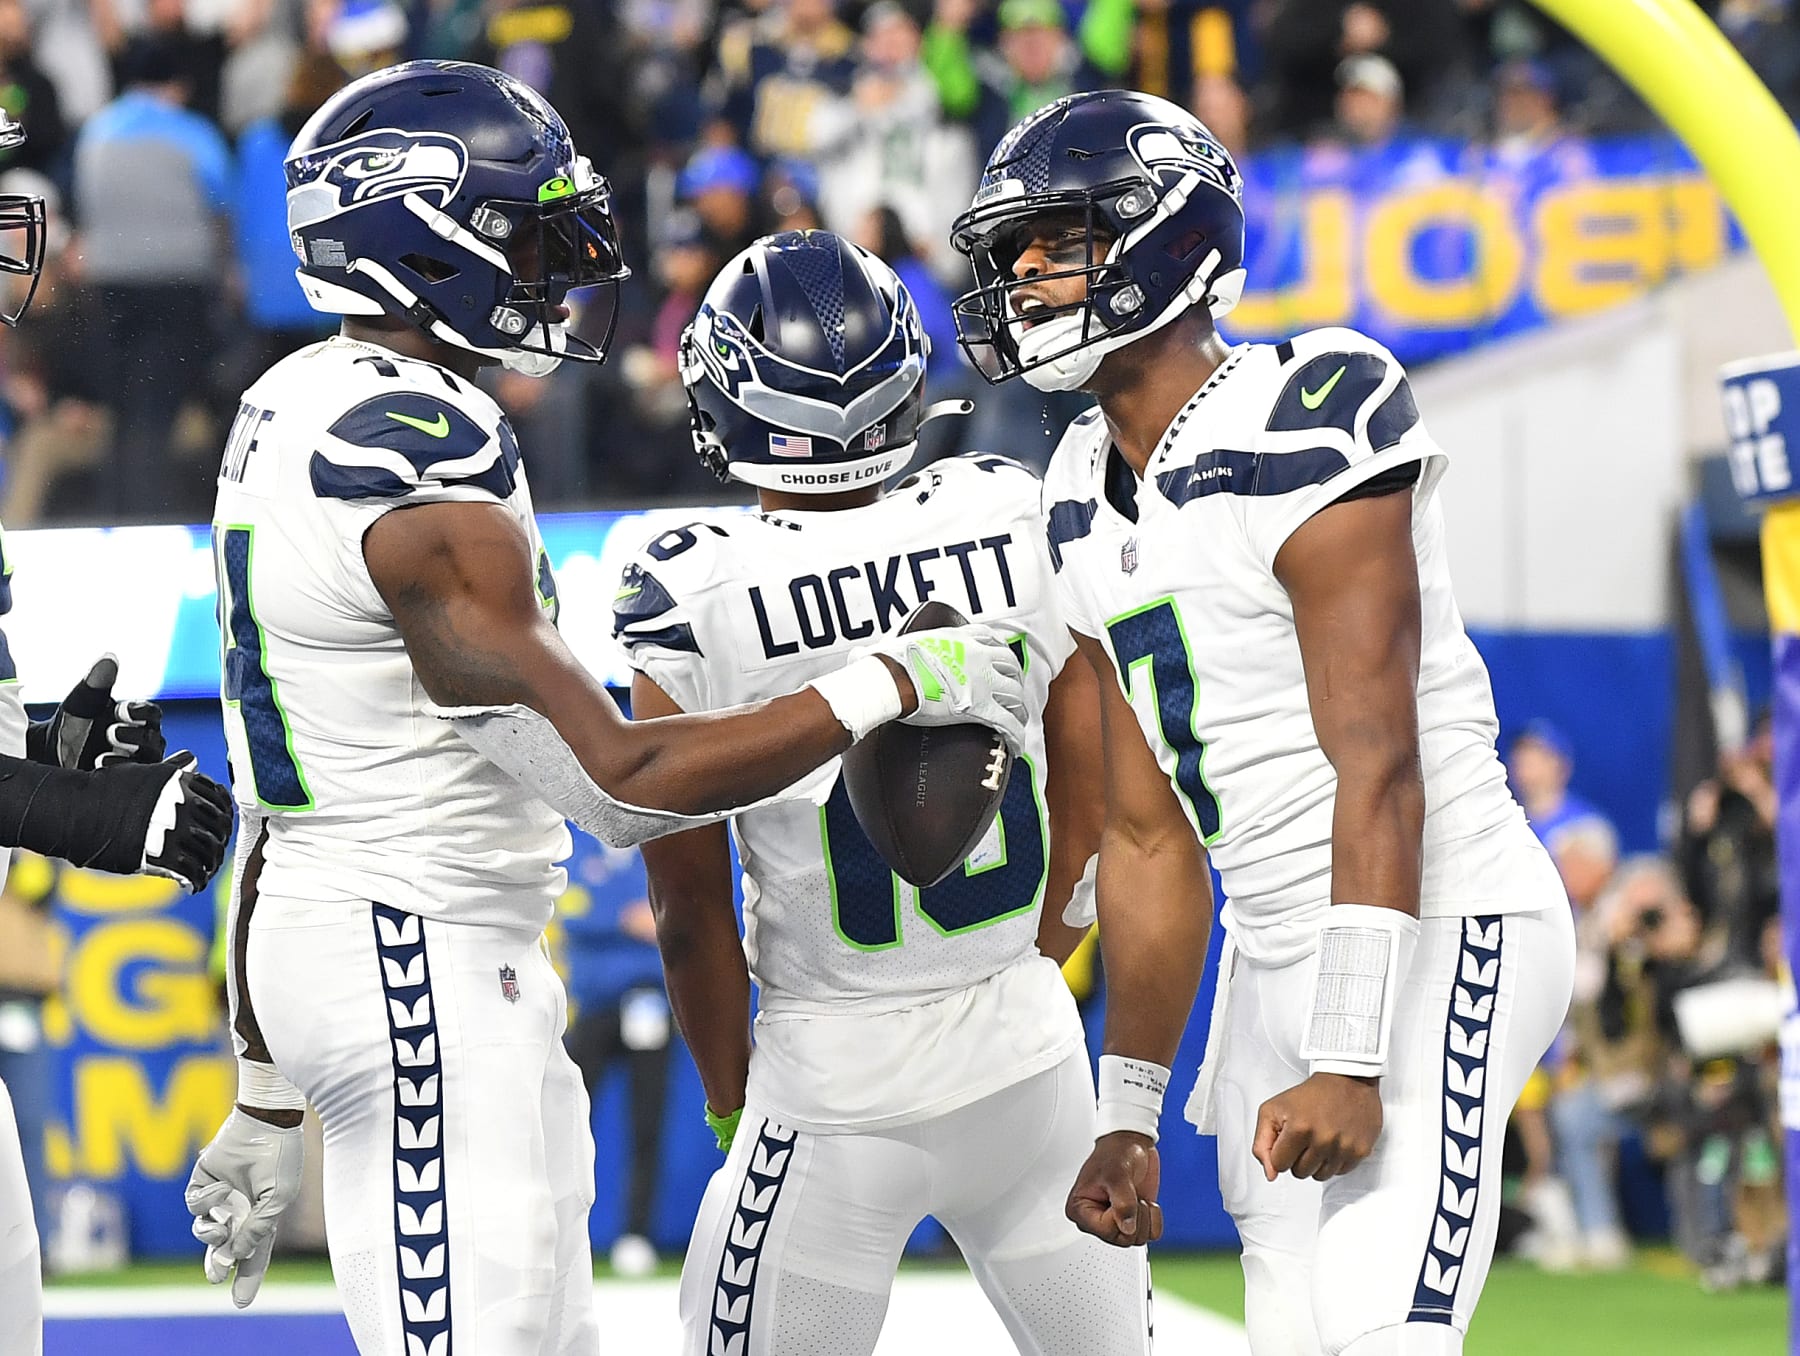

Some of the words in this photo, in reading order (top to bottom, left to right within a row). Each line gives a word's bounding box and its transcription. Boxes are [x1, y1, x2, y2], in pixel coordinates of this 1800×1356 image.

[781, 472, 851, 485] CHOOSE
[855, 460, 893, 481] LOVE
[748, 533, 1017, 660] LOCKETT
[1104, 594, 1223, 848] 7
[916, 762, 929, 808] LEAGUE
